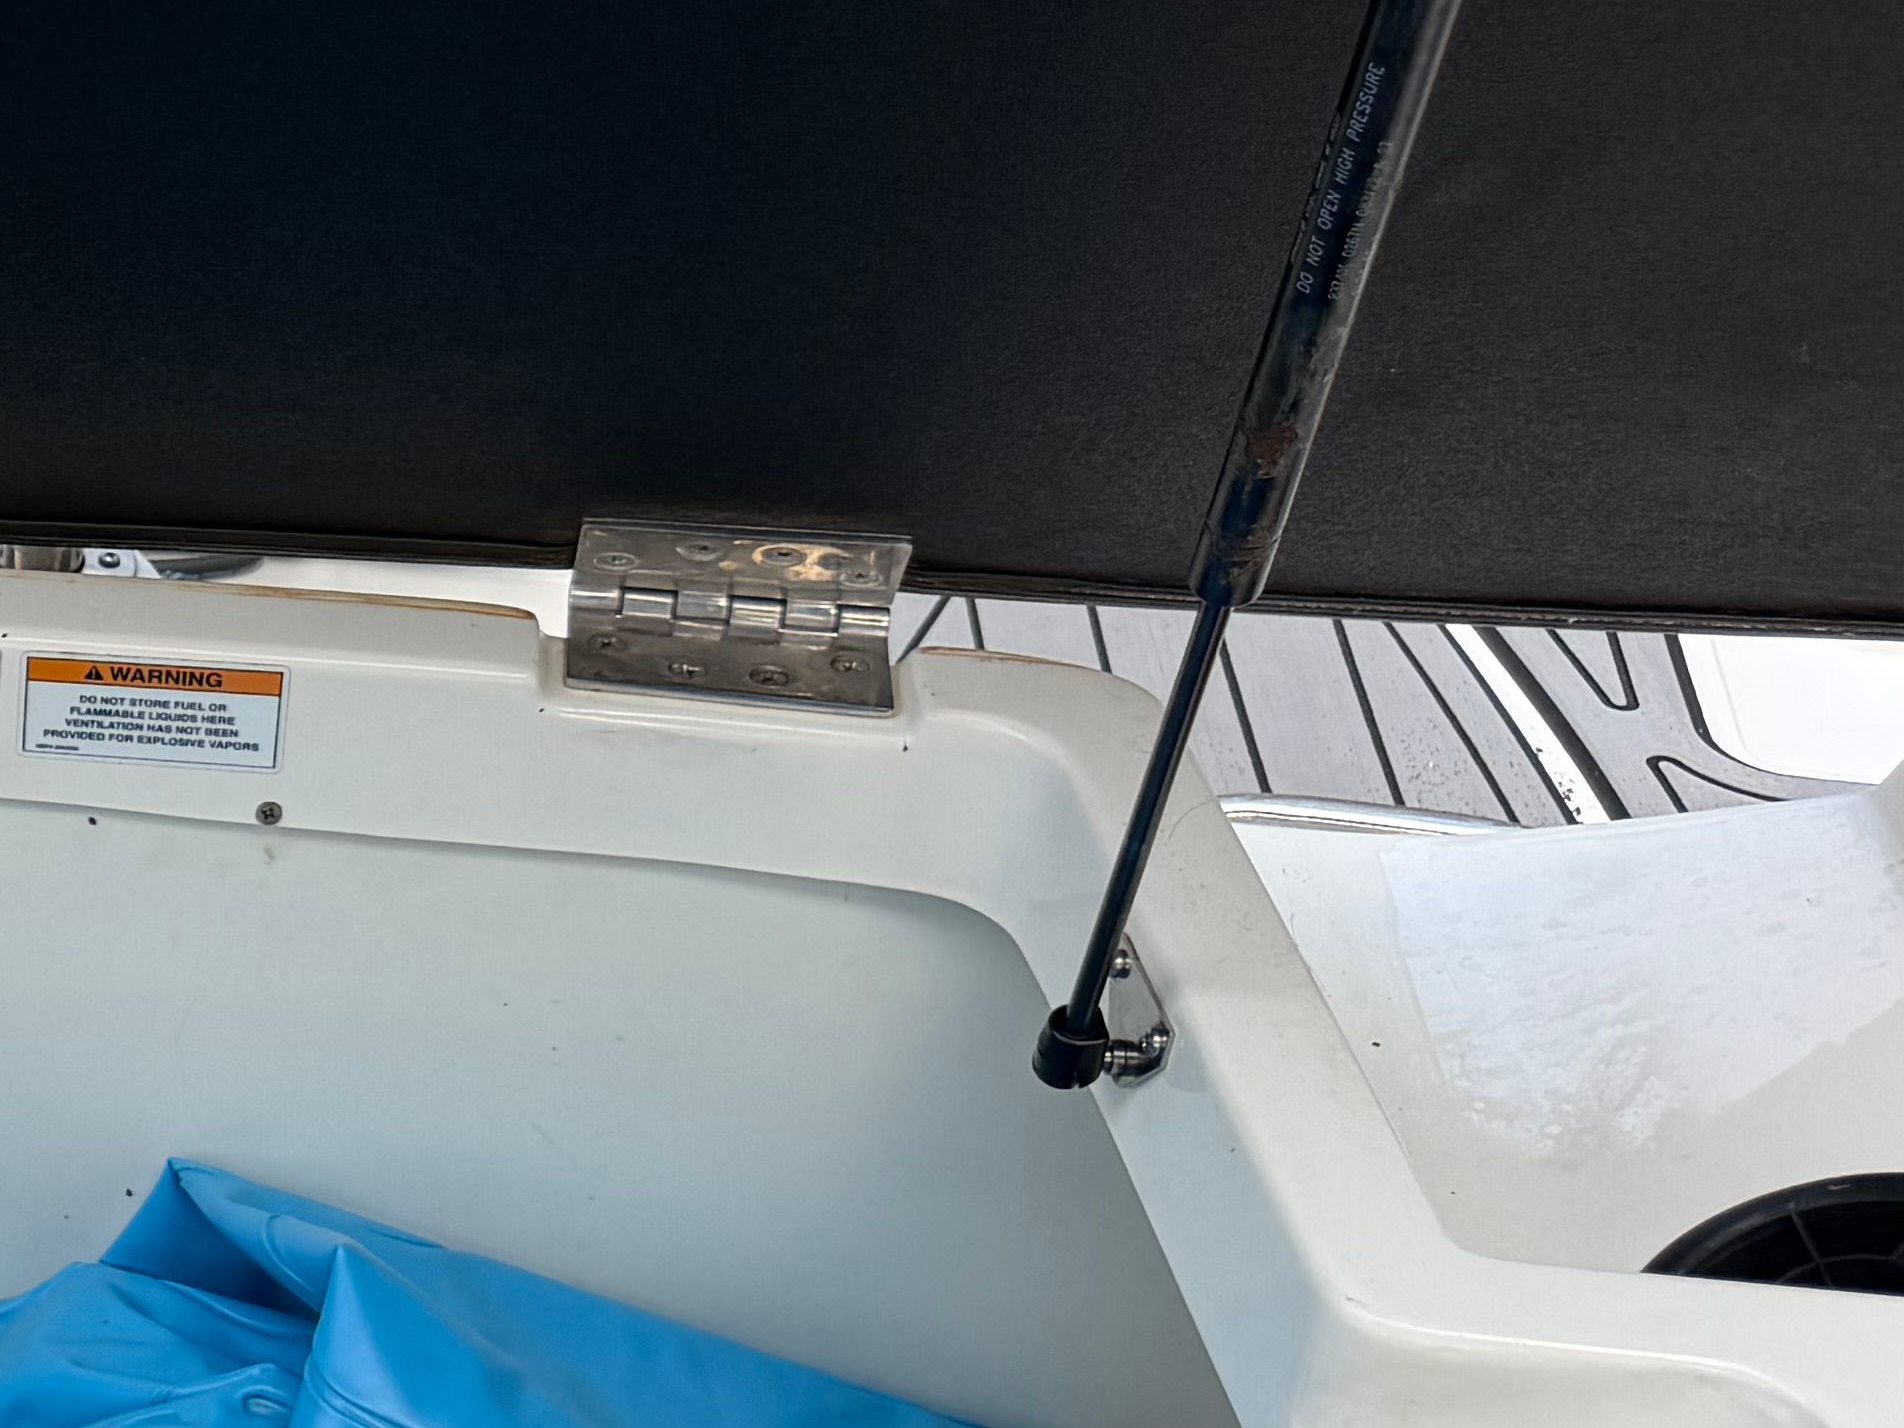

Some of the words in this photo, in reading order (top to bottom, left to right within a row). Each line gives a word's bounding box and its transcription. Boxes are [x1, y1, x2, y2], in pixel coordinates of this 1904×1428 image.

[1296, 272, 1313, 293] DO
[1306, 235, 1324, 266] NOT
[1317, 190, 1341, 229] OPEN
[1335, 148, 1355, 184] HIGH
[1347, 63, 1385, 141] PRESSURE
[110, 666, 222, 688] WARNING
[79, 695, 97, 704] DO
[100, 696, 125, 706] NOT
[129, 698, 170, 709] STORE
[173, 701, 205, 711] FUEL
[208, 703, 226, 712] OR
[69, 706, 145, 720] FLAMMABLE
[149, 711, 198, 723] LIQUIDS
[201, 714, 235, 725] HERE
[65, 718, 143, 732] VENTILATION
[147, 723, 172, 734] HAS
[176, 725, 201, 736] NOT
[205, 727, 238, 737] BEEN
[43, 729, 105, 742] PROVIDED
[108, 733, 133, 743] FOR
[137, 735, 205, 748] EXPLOSIVE
[209, 739, 259, 751] VAPORS
